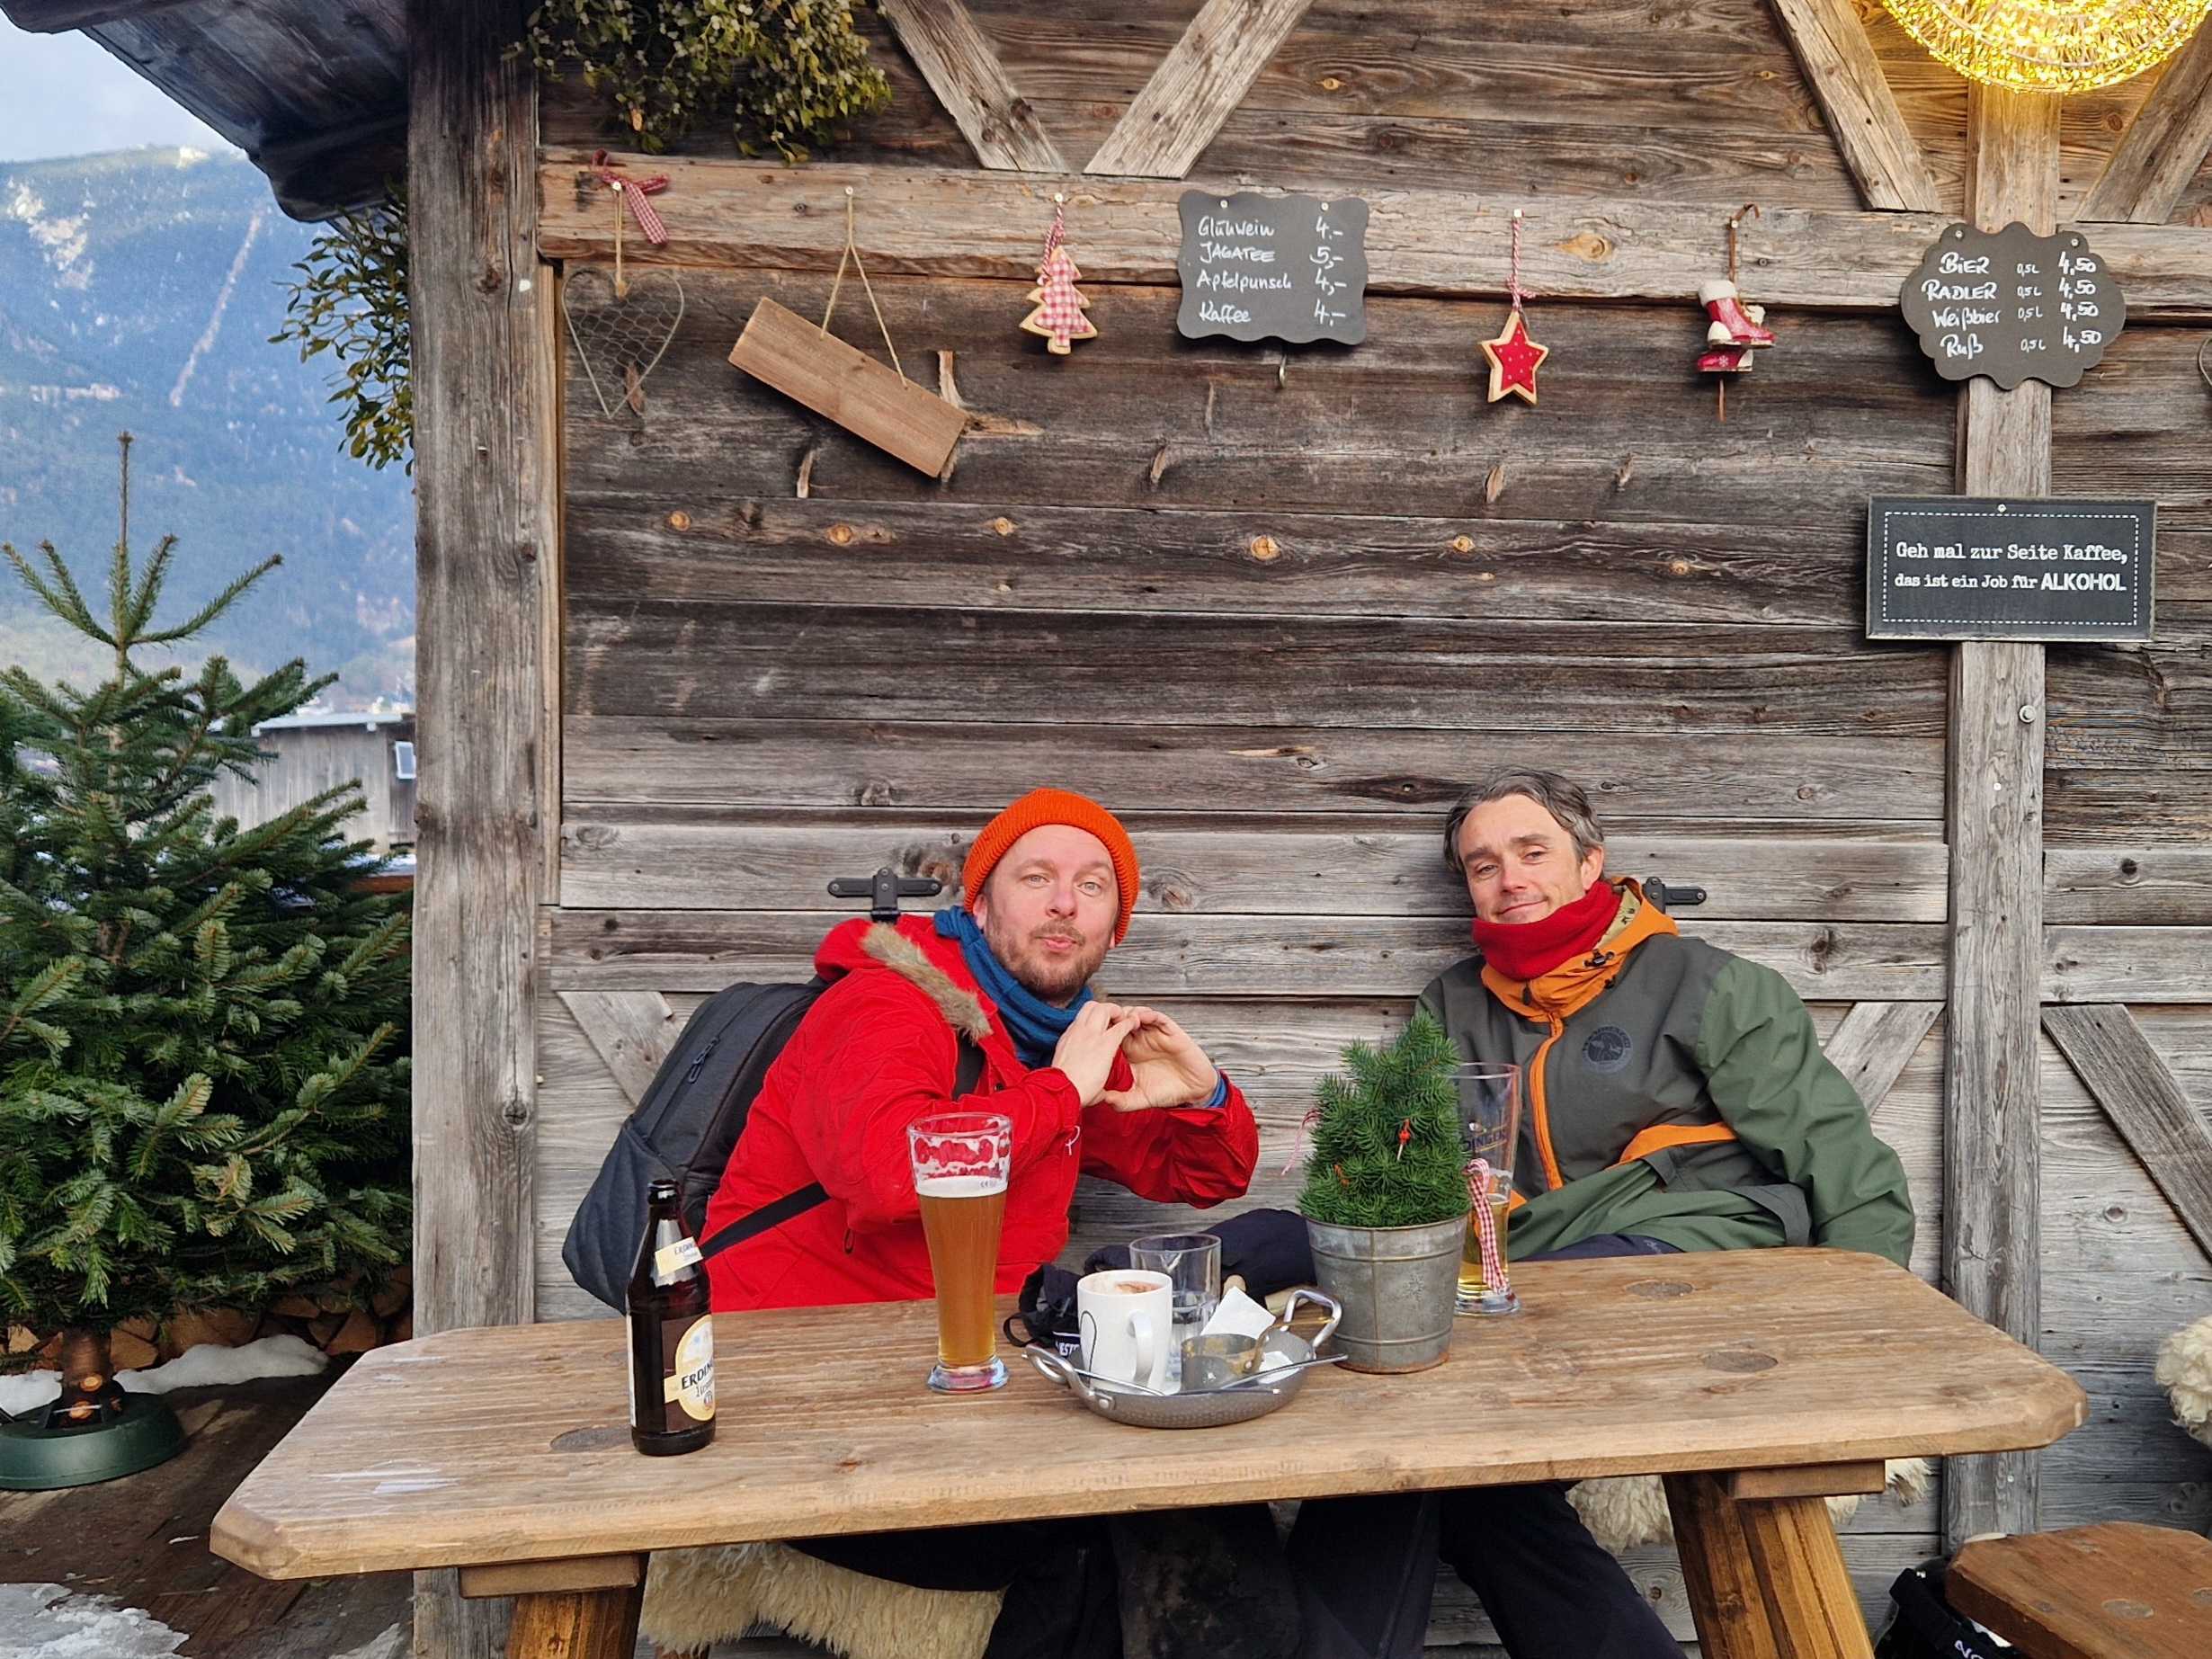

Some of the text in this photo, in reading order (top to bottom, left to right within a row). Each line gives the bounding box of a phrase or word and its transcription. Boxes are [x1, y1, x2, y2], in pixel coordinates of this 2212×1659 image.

[1198, 215, 1275, 237] Glühwein
[1200, 241, 1276, 264] JAGATEE
[2057, 251, 2098, 275] 4,50
[1196, 269, 1292, 294] Apfelpunsch
[1921, 280, 1997, 302] RADLER
[2058, 276, 2097, 300] 4,50
[1199, 299, 1252, 325] Kaffee
[1931, 305, 2001, 331] Weißbier
[2060, 300, 2100, 322] 4,50
[2062, 326, 2102, 353] 4,50
[1895, 541, 2128, 565] Geh mal zur Seite Kaffee,
[1894, 572, 2127, 592] das ist ein Job für ALKOHOL
